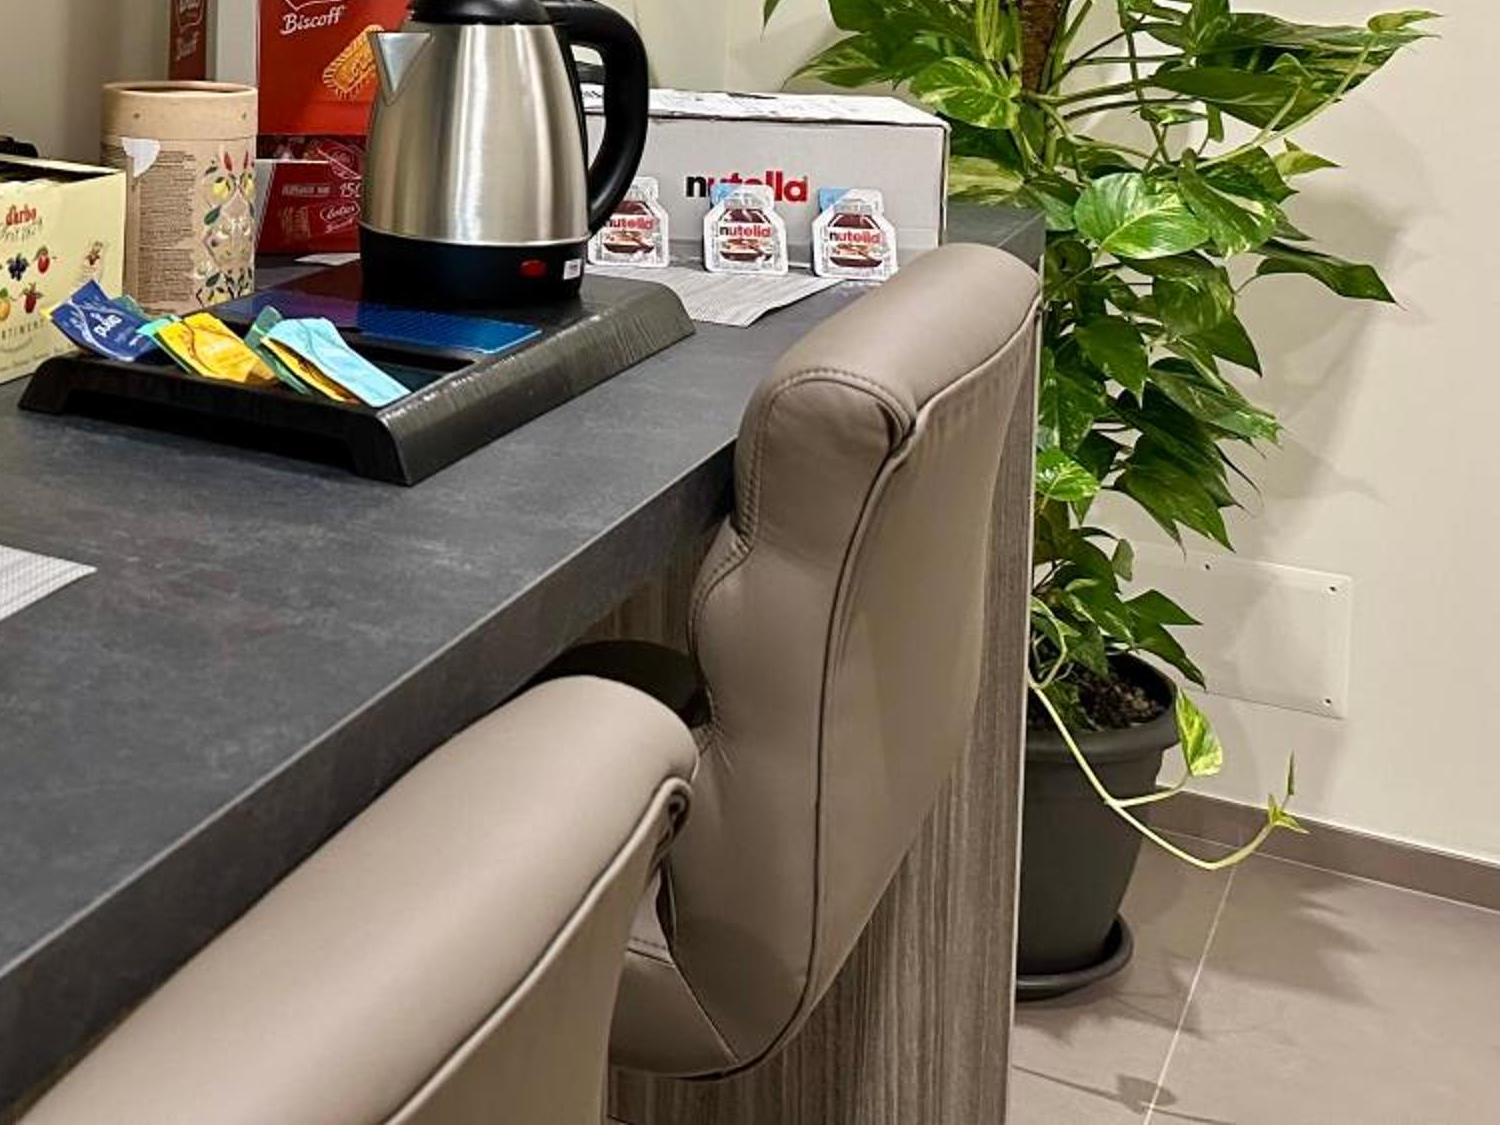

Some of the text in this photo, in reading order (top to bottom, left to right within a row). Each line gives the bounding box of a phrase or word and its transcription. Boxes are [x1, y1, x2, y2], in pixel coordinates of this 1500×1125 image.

[279, 5, 342, 35] Biscoff
[719, 224, 773, 238] nutella
[829, 230, 881, 244] nutella
